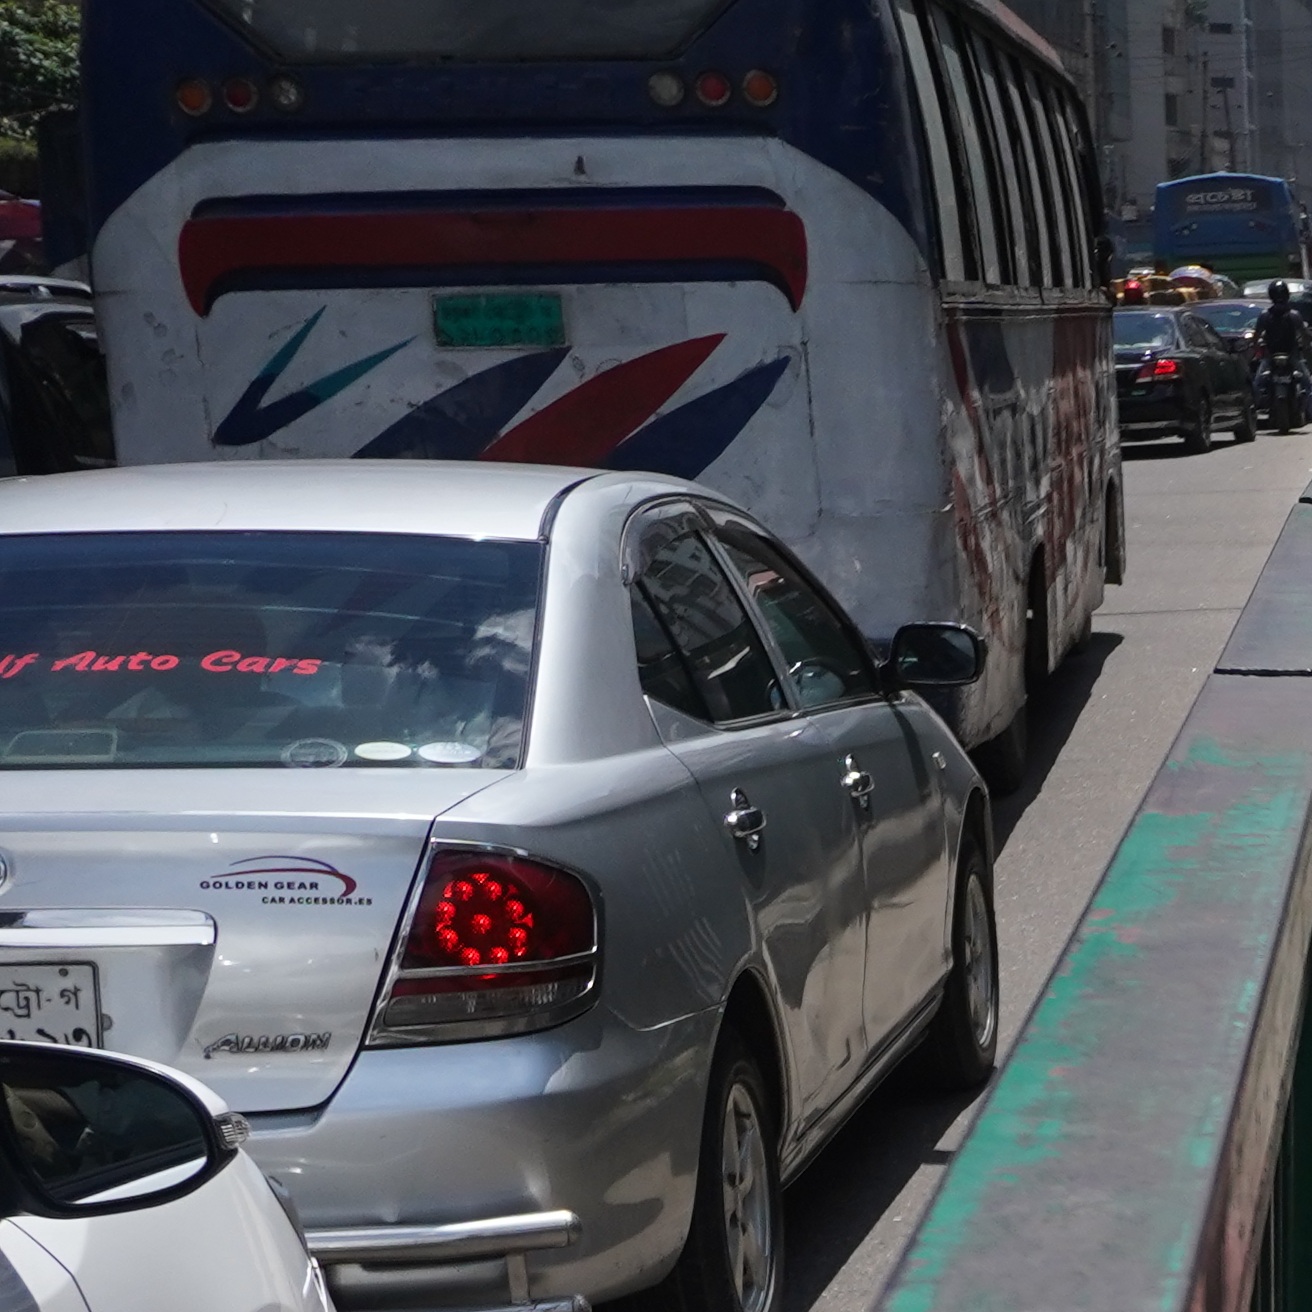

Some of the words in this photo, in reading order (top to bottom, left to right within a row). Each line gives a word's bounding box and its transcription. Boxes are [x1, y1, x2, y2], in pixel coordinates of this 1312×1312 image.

[51, 650, 181, 672] Auto
[200, 650, 322, 675] Cars
[199, 880, 269, 891] GOLDEN
[273, 880, 320, 891] GEAR
[261, 896, 286, 905] CAR
[289, 896, 373, 906] ACCESSORES
[203, 1031, 332, 1060] ALLION
